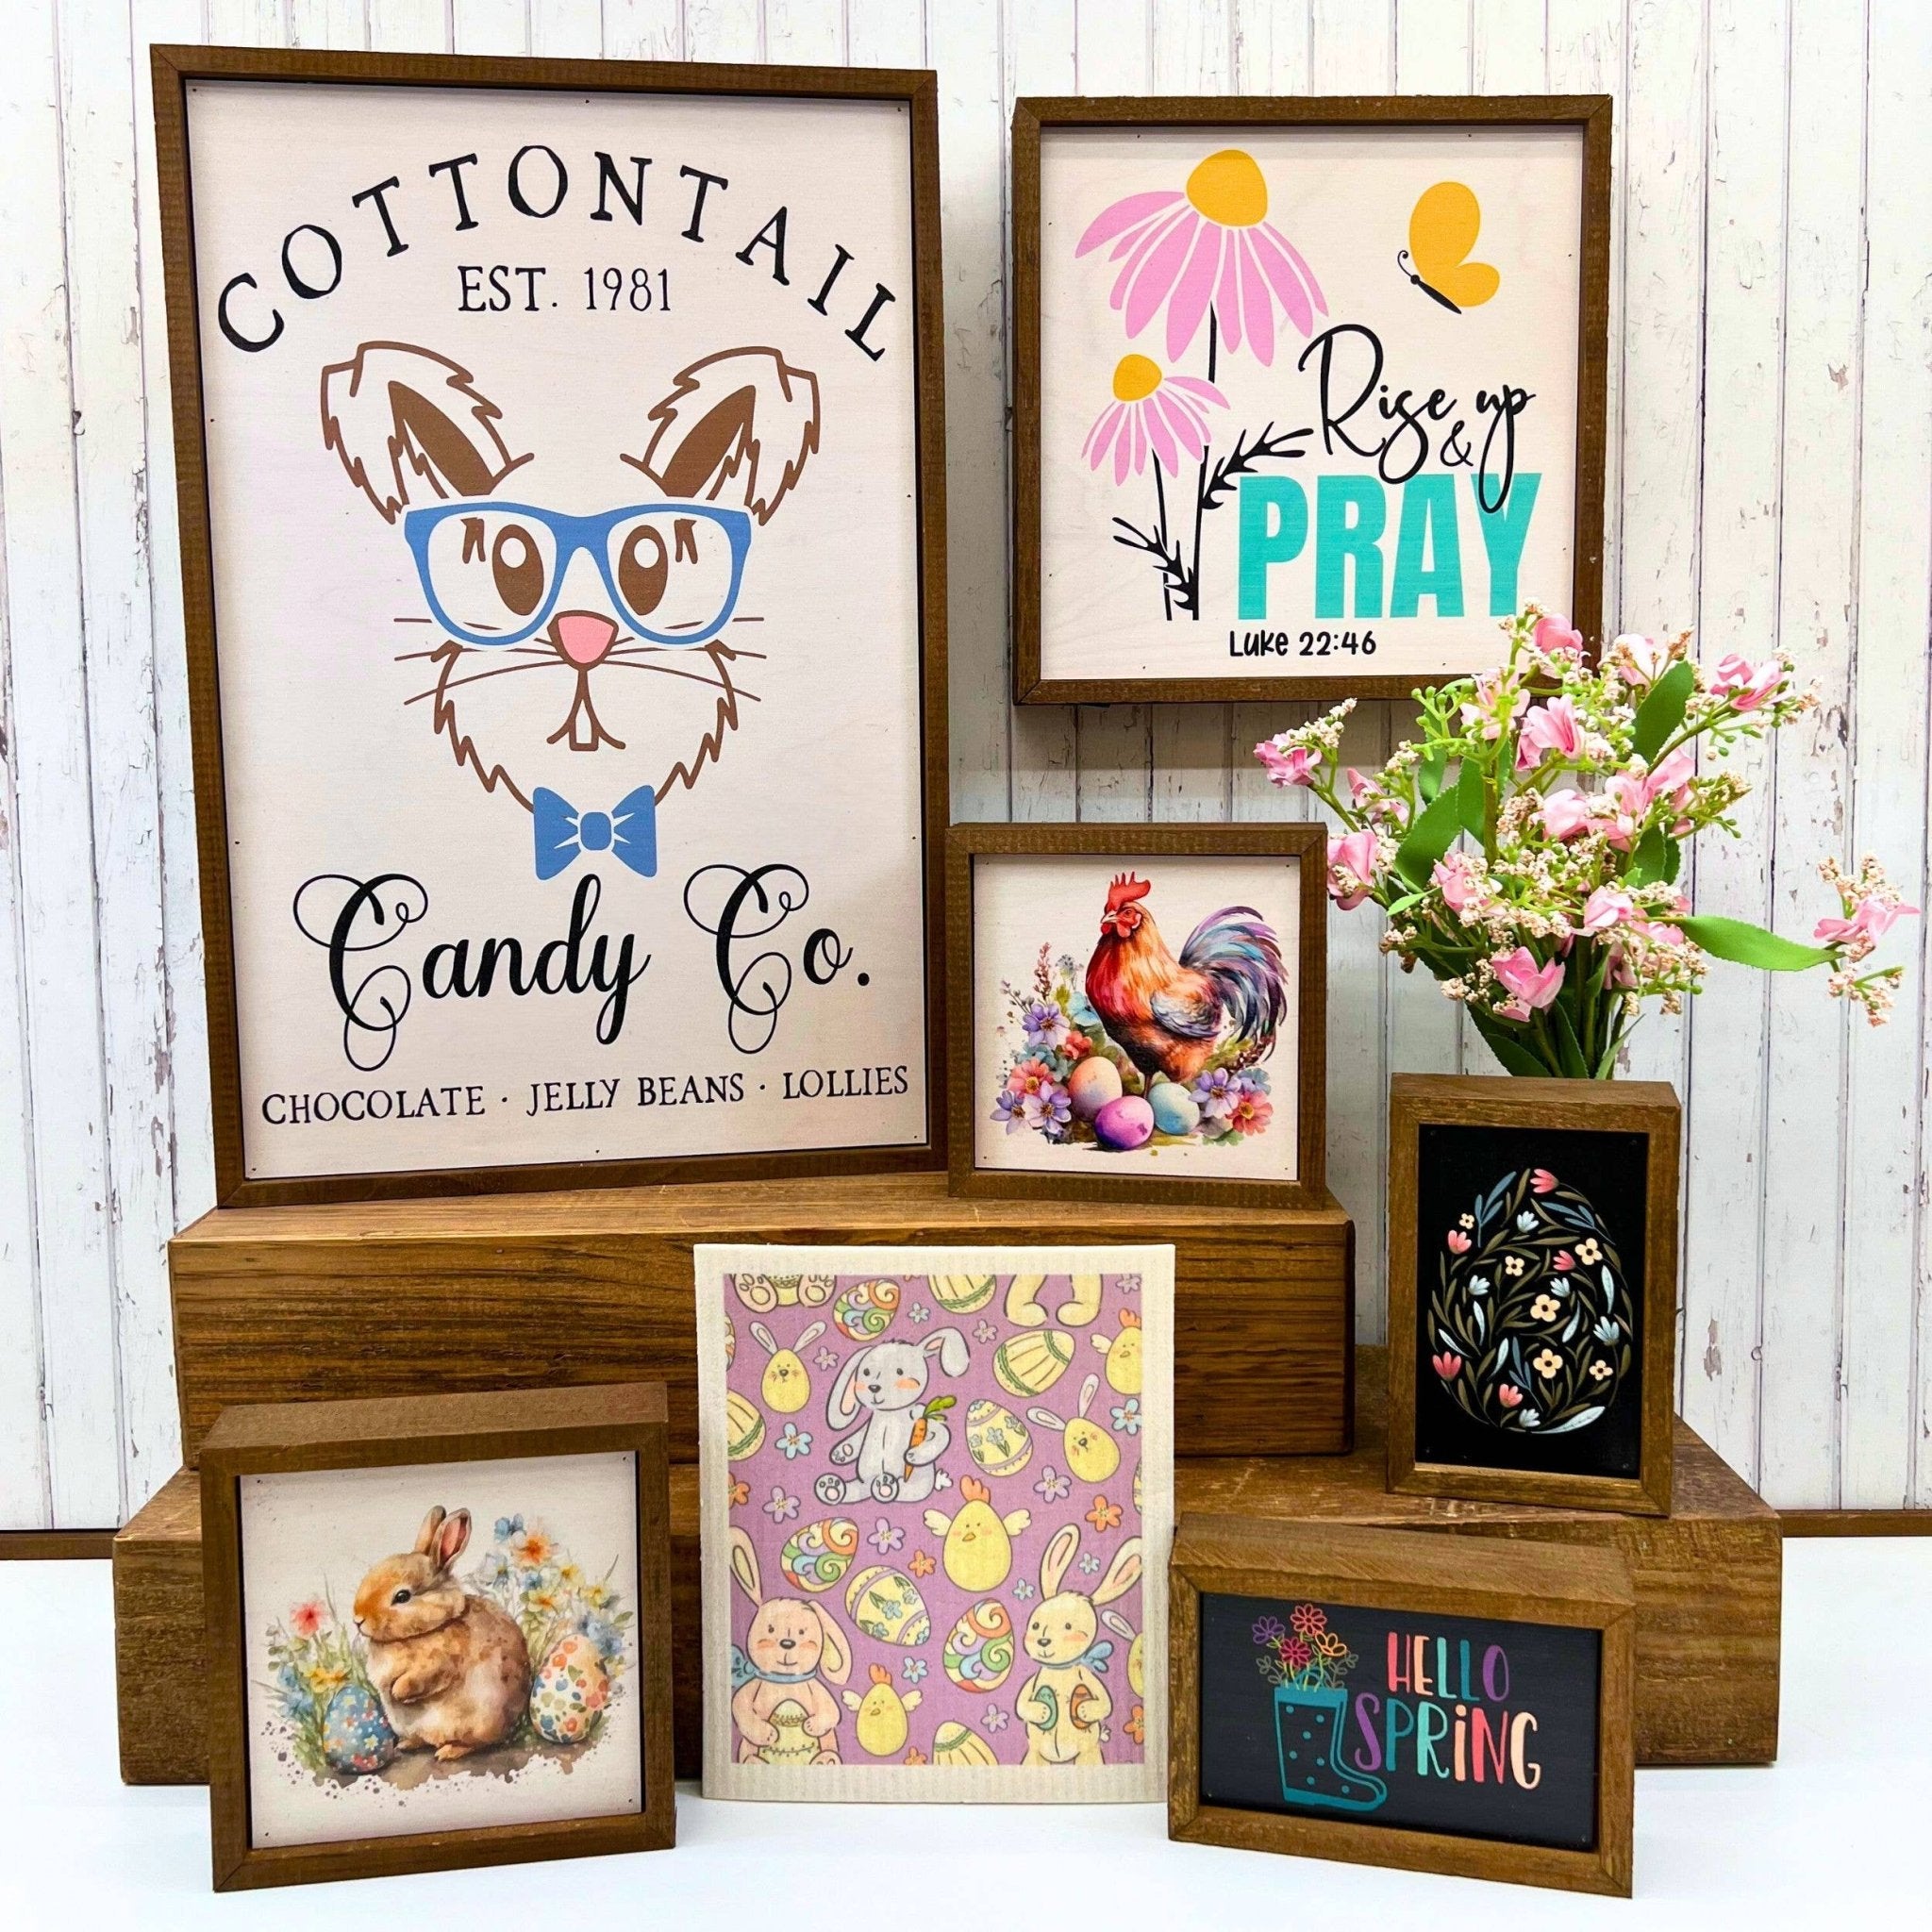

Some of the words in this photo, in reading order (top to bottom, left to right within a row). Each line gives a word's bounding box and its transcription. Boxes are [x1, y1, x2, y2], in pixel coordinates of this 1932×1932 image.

[217, 144, 898, 362] COTTONTAIL
[458, 264, 558, 313] EST.
[584, 268, 674, 313] 1981
[1297, 324, 1457, 485] Rise
[1475, 384, 1537, 514] up
[1441, 421, 1474, 467] &
[1238, 473, 1542, 620] PRAY
[1229, 630, 1289, 658] Luke
[1298, 629, 1377, 657] 22:46
[292, 873, 652, 1072] Candy
[683, 863, 871, 1055] Co.
[261, 1085, 486, 1125] CHOCOLATE
[526, 1077, 620, 1117] JELLY
[637, 1073, 745, 1108] BEANS
[782, 1065, 909, 1101] LOLLIES
[1387, 1631, 1509, 1701] HELLO
